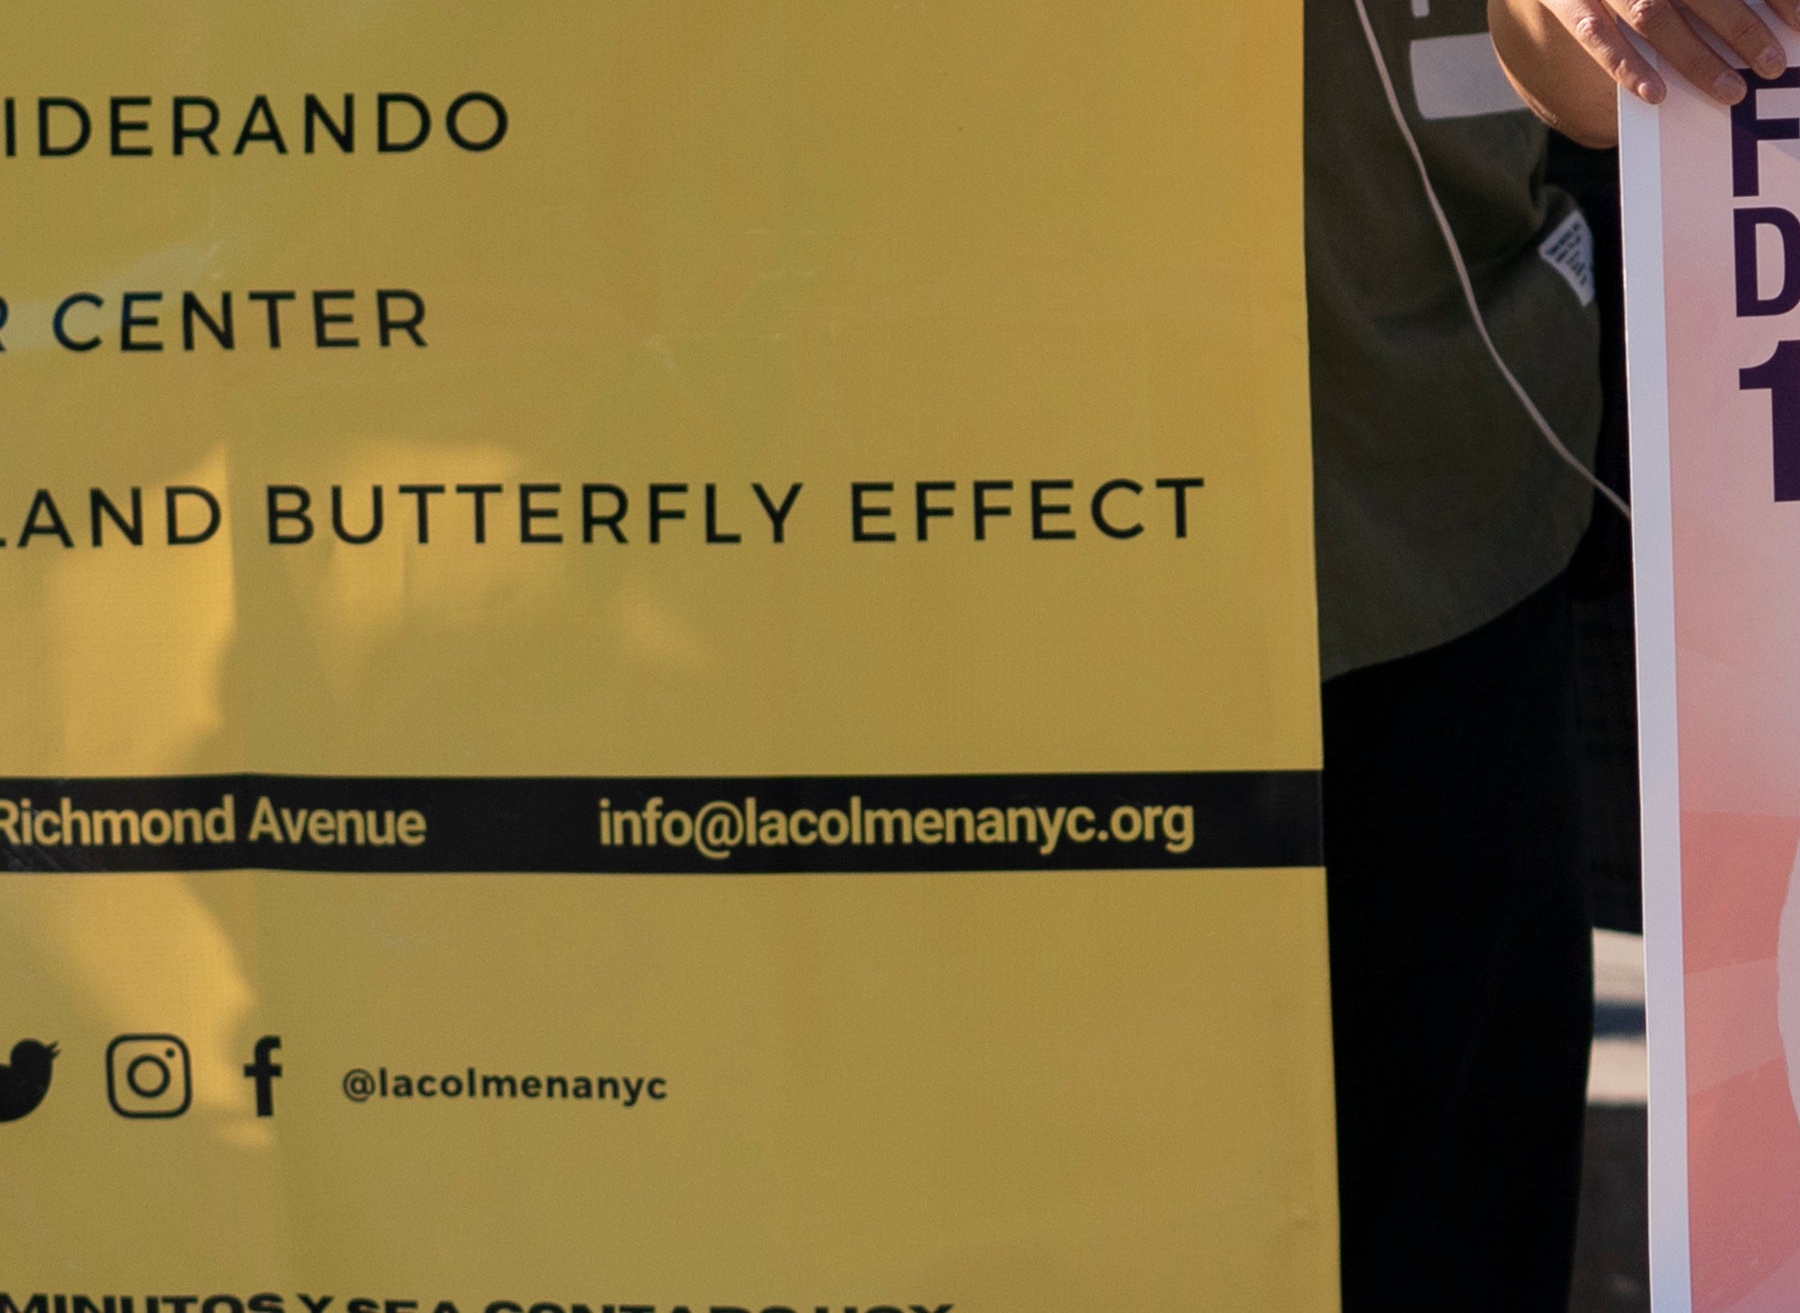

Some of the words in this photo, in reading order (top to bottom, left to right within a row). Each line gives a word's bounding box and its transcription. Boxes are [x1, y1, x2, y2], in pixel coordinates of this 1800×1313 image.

[3, 90, 510, 158] IDERANDO
[52, 288, 428, 353] CENTER
[265, 481, 804, 546] BUTTERFLY
[850, 475, 1206, 544] EFFECT
[0, 794, 236, 847] Richmond
[247, 796, 428, 847] Avenue
[598, 795, 1196, 860] info@lacolmenanyc.org
[341, 1066, 668, 1108] @lacolmenanyc
